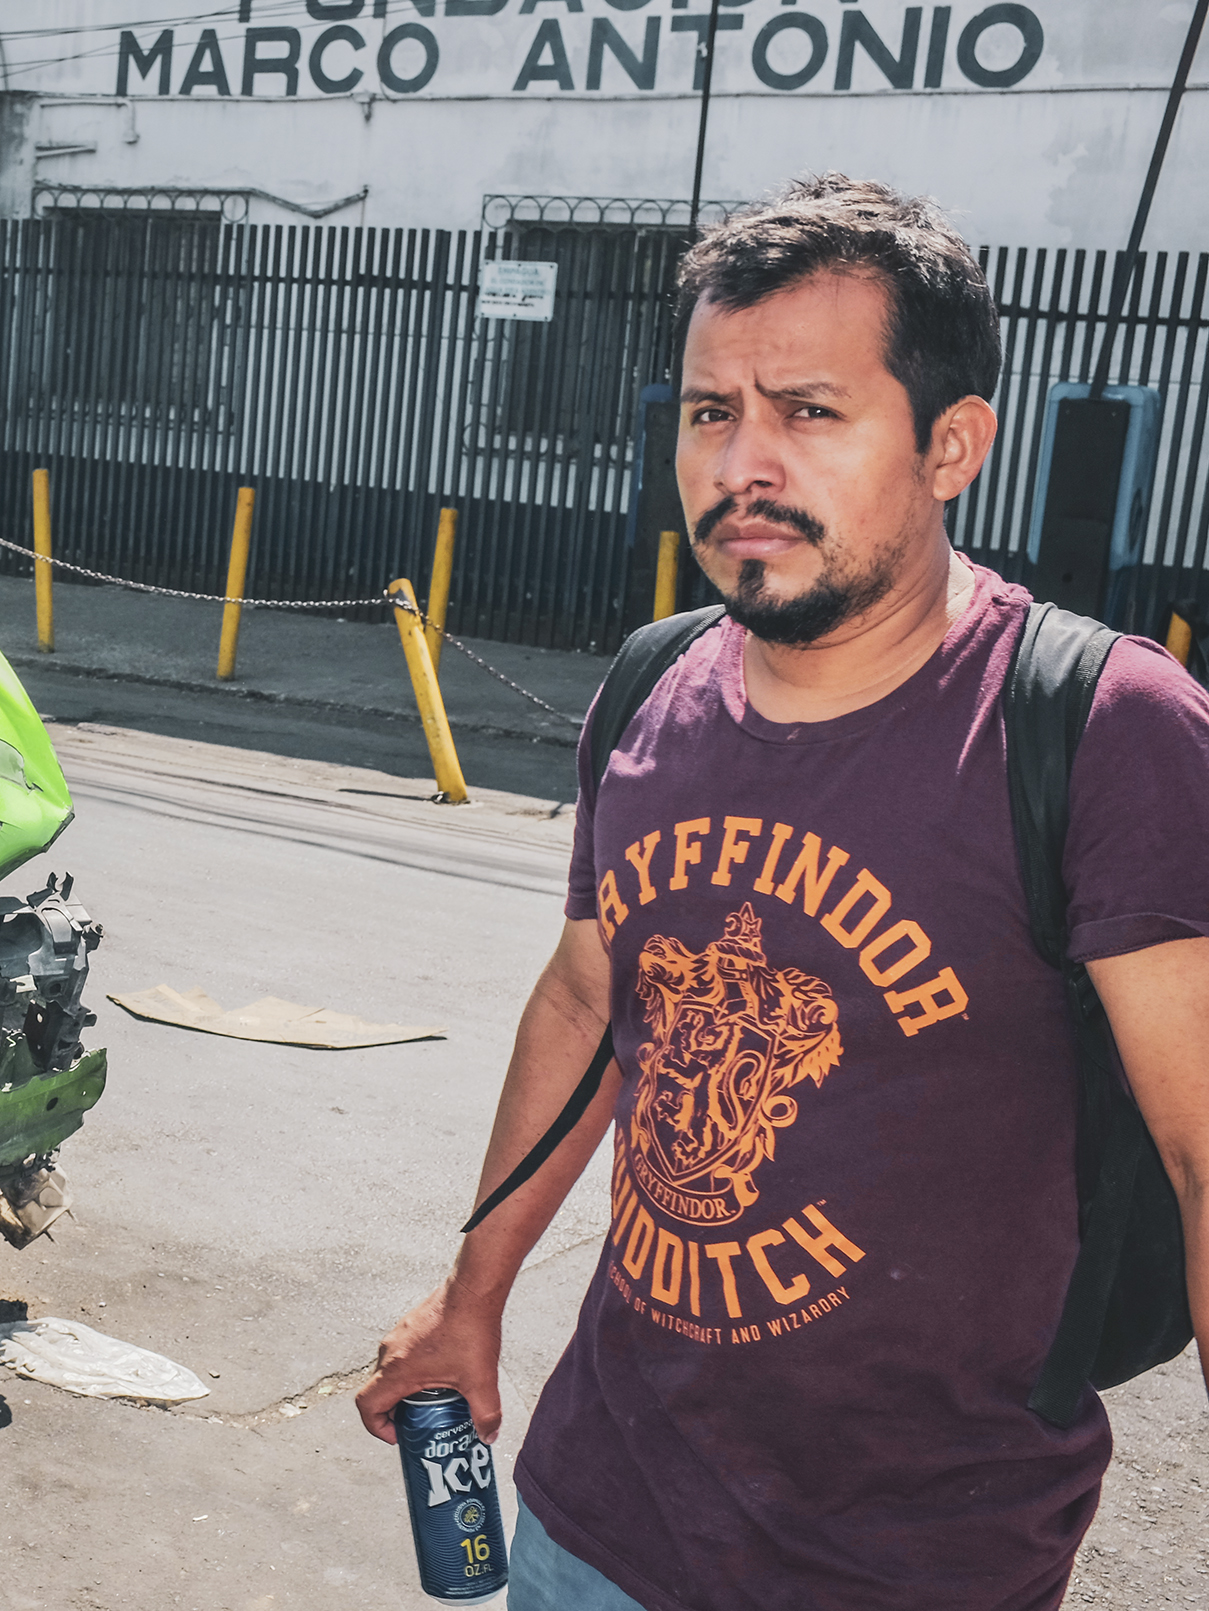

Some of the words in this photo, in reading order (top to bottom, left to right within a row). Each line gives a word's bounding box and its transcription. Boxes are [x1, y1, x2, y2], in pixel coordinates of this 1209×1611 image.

[116, 23, 440, 96] MARCO
[512, 3, 1044, 92] ANTONIO
[598, 816, 970, 1038] RYFFINDOR
[633, 1296, 647, 1315] OF
[651, 1308, 722, 1345] WITCHCRAFT
[731, 1324, 762, 1345] AND
[766, 1286, 851, 1338] WIZARDRY
[425, 1424, 479, 1458] dorad
[460, 1534, 490, 1564] 16
